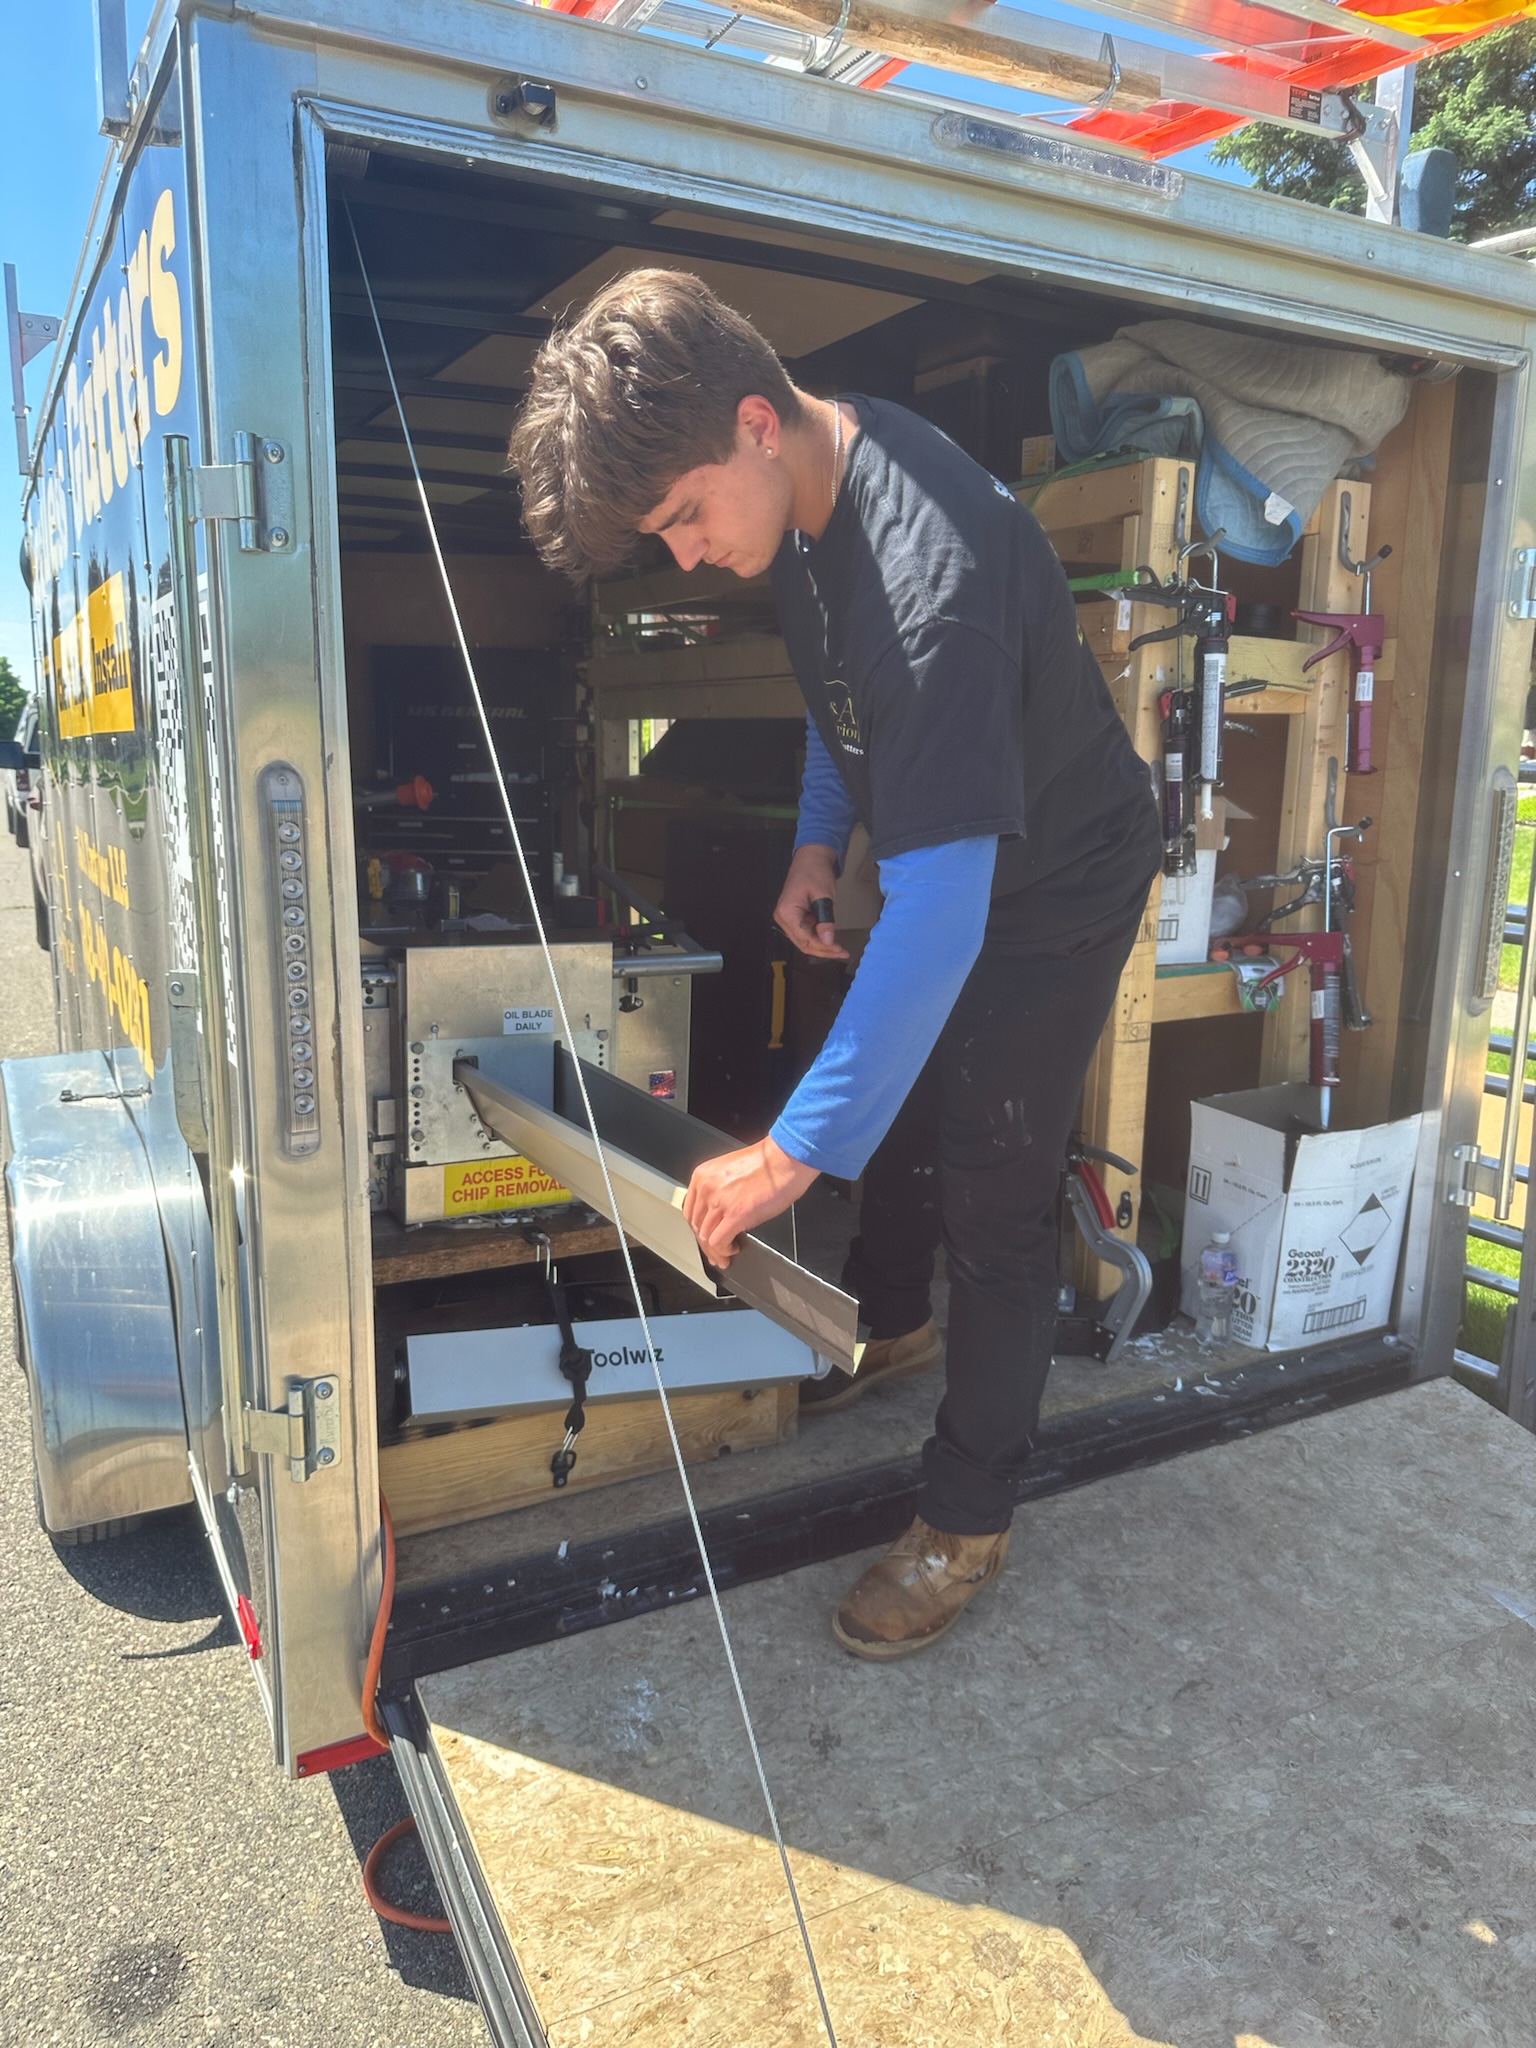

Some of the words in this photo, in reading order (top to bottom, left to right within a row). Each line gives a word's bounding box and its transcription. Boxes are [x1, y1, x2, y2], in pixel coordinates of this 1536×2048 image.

[65, 188, 182, 541] Gutters
[91, 621, 128, 696] Install
[440, 705, 528, 719] GENRAL
[107, 844, 130, 911] LLC
[504, 1011, 520, 1020] OIL
[522, 1009, 553, 1019] BLADE
[515, 1022, 543, 1031] DAILY
[462, 1166, 524, 1186] ACCESS
[529, 1165, 549, 1178] FO
[452, 1187, 490, 1203] CHIP
[1288, 1248, 1325, 1258] Geocel
[1285, 1255, 1336, 1277] 2320
[588, 1346, 665, 1368] oolwiz
